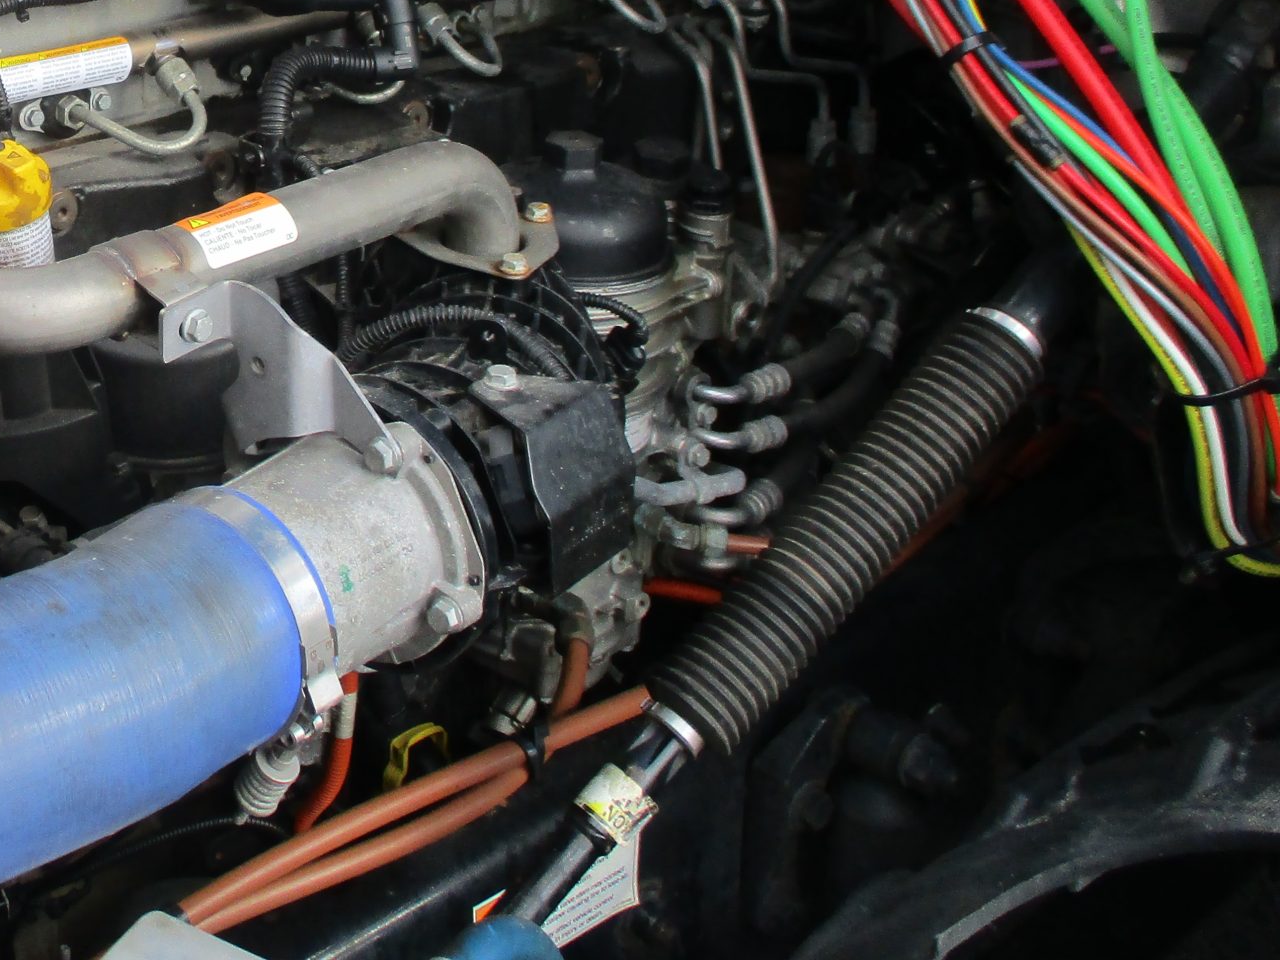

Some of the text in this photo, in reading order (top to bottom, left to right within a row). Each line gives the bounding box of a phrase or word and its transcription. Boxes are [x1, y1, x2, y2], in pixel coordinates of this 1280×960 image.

[204, 231, 234, 246] CALIENTE
[246, 223, 262, 233] Tocar
[208, 242, 231, 254] CHAUD
